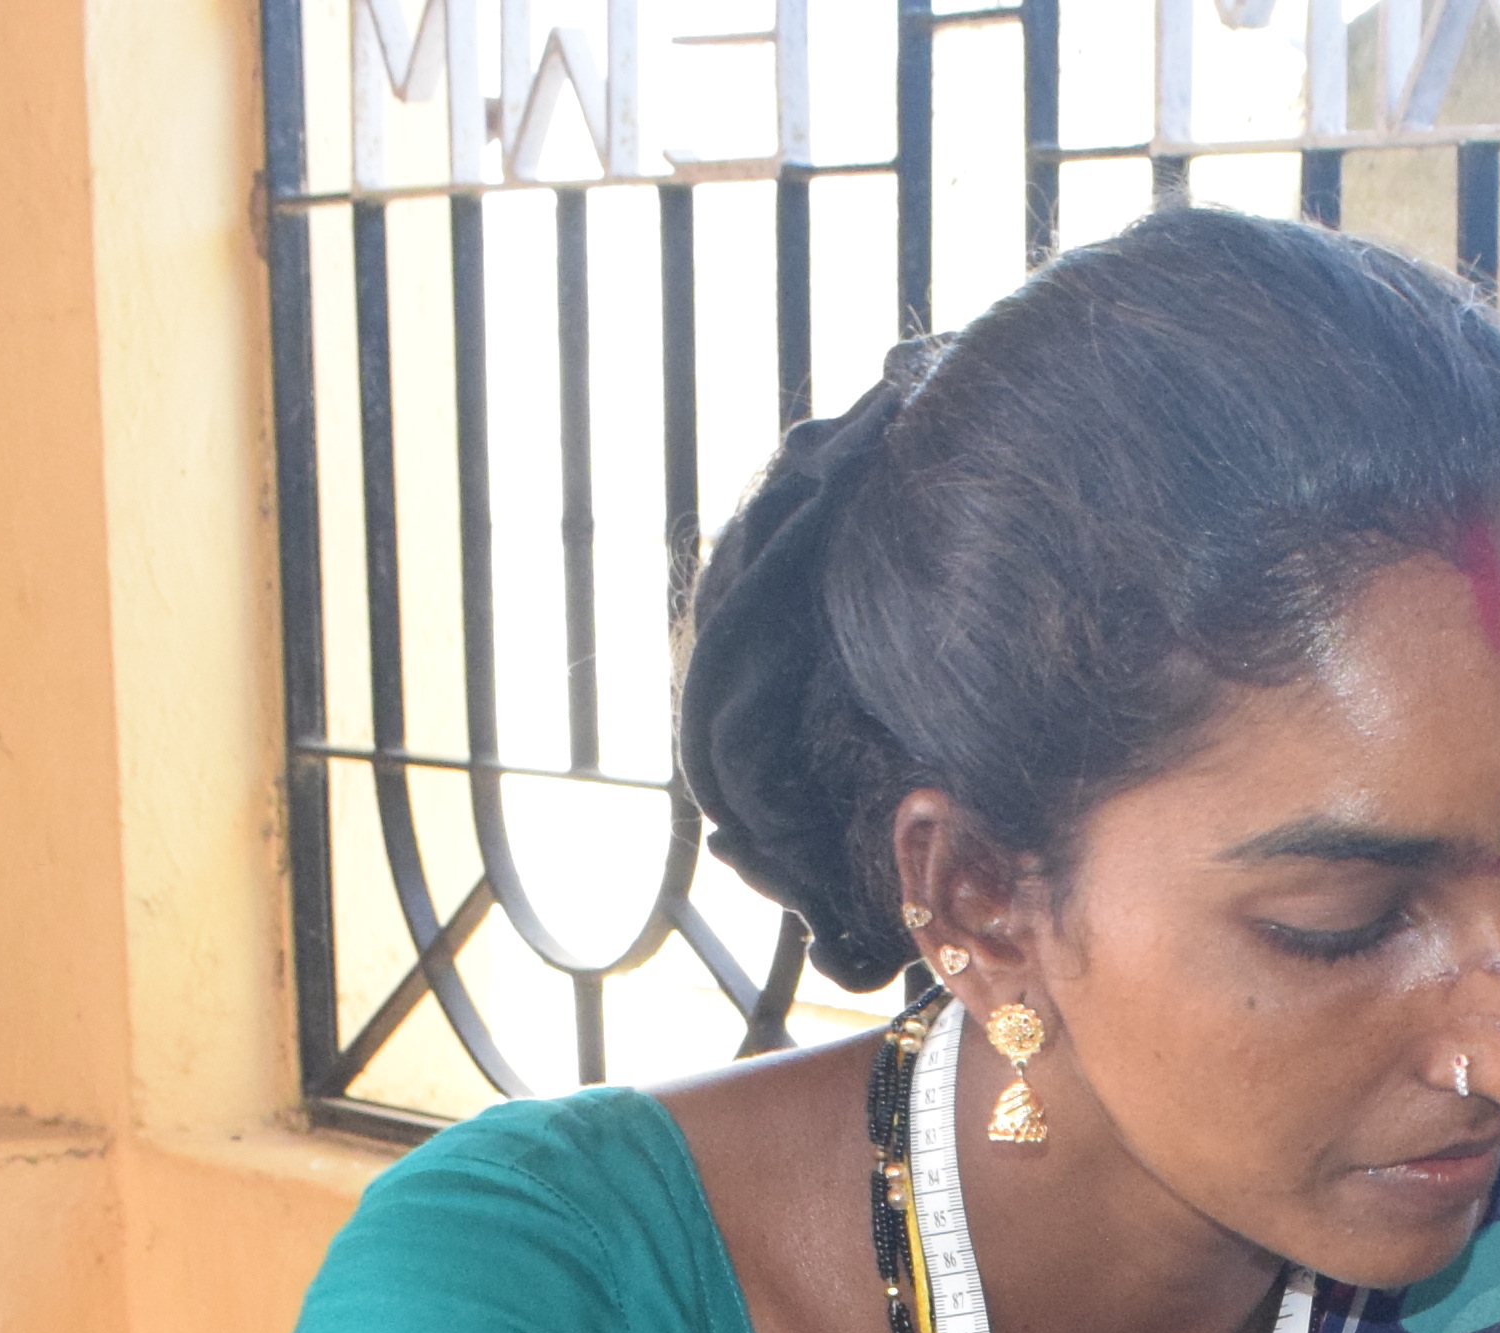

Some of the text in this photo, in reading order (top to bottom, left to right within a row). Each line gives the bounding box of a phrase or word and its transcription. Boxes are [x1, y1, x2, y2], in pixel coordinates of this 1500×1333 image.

[925, 1129, 937, 1144] 83
[928, 1170, 940, 1185] 84
[934, 1211, 947, 1227] 85
[943, 1252, 957, 1268] 86
[952, 1292, 965, 1309] 87
